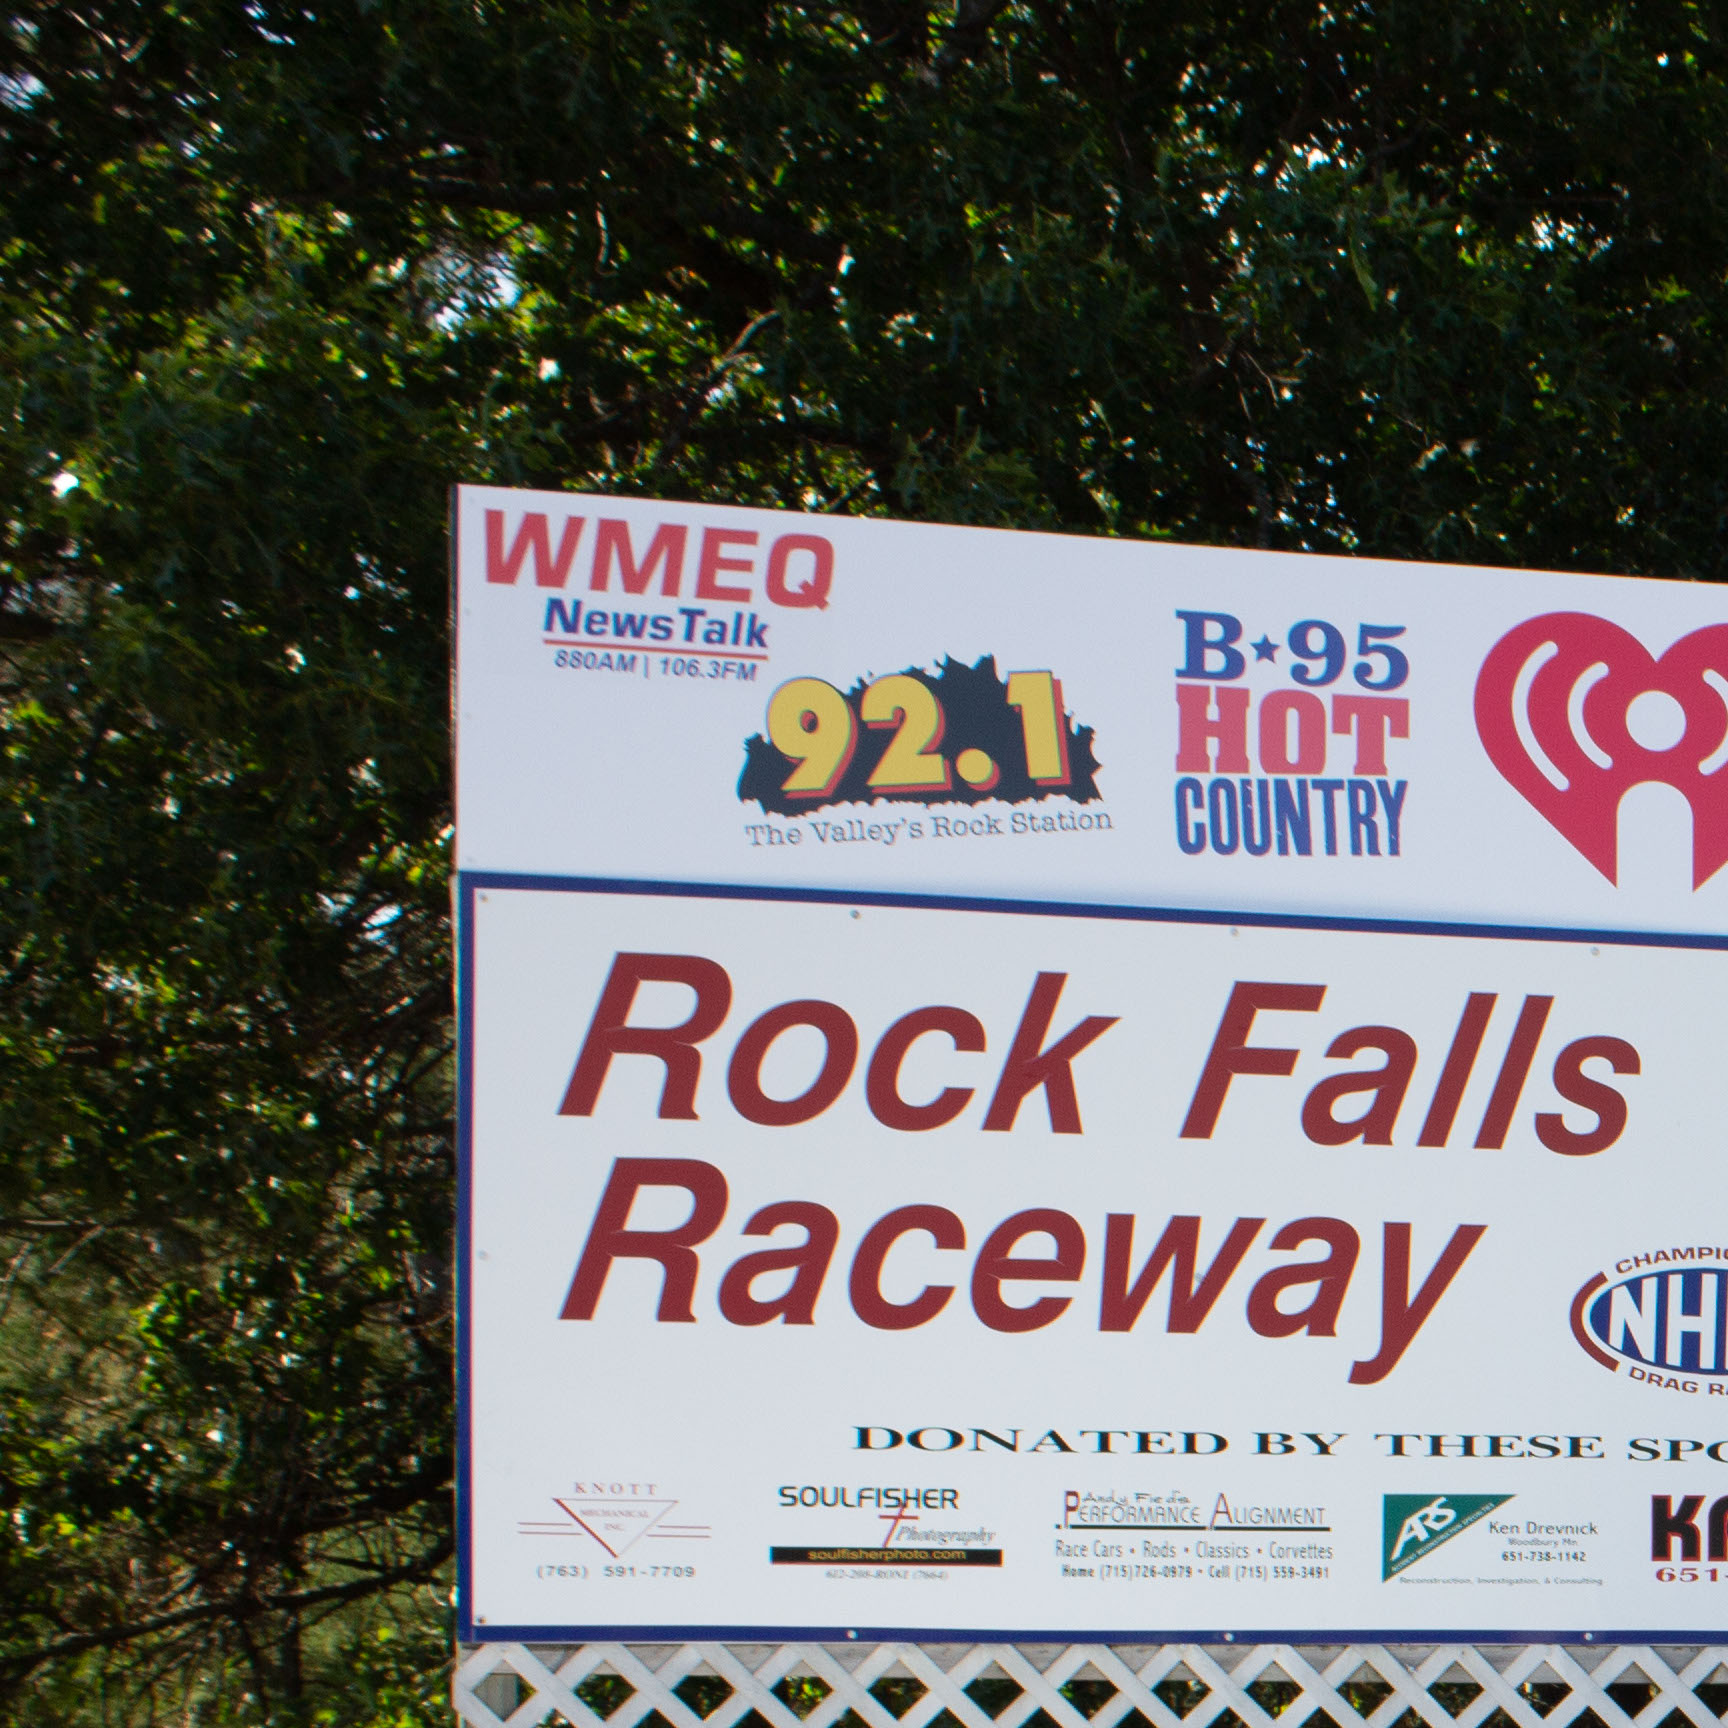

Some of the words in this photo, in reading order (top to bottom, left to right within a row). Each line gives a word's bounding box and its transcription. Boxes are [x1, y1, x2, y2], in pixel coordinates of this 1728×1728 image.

[484, 508, 835, 610] WMEQ
[543, 597, 768, 650] NewsTalk
[554, 650, 637, 674] 880AM
[658, 657, 758, 682] 106.3FM
[767, 671, 1072, 800] 92.1
[1175, 684, 1411, 777] HOT
[745, 823, 802, 847] The
[808, 817, 924, 845] Valley's
[932, 814, 1004, 841] Rock
[1010, 807, 1114, 836] Station
[1174, 776, 1409, 857] COUNTRY
[556, 951, 1123, 1135] Rock
[1179, 980, 1642, 1157] Falls
[556, 1156, 1489, 1386] Raceway
[1628, 1365, 1700, 1396] DRAG
[851, 1425, 1230, 1456] DONATED
[1250, 1431, 1350, 1457] BY
[1374, 1433, 1606, 1460] THESE
[574, 1481, 658, 1496] KNOTT
[778, 1486, 960, 1509] SOULFISHER
[1064, 1490, 1201, 1526] PERFORMANCE
[1210, 1492, 1327, 1529] ALIGNMENT
[1489, 1520, 1520, 1535] Ken
[1526, 1520, 1599, 1536] Drevnick
[1055, 1539, 1089, 1558] Race
[1093, 1539, 1123, 1558] Cars
[1143, 1540, 1177, 1558] Rods
[1196, 1541, 1250, 1559] Classics
[1269, 1542, 1333, 1560] Corvettes
